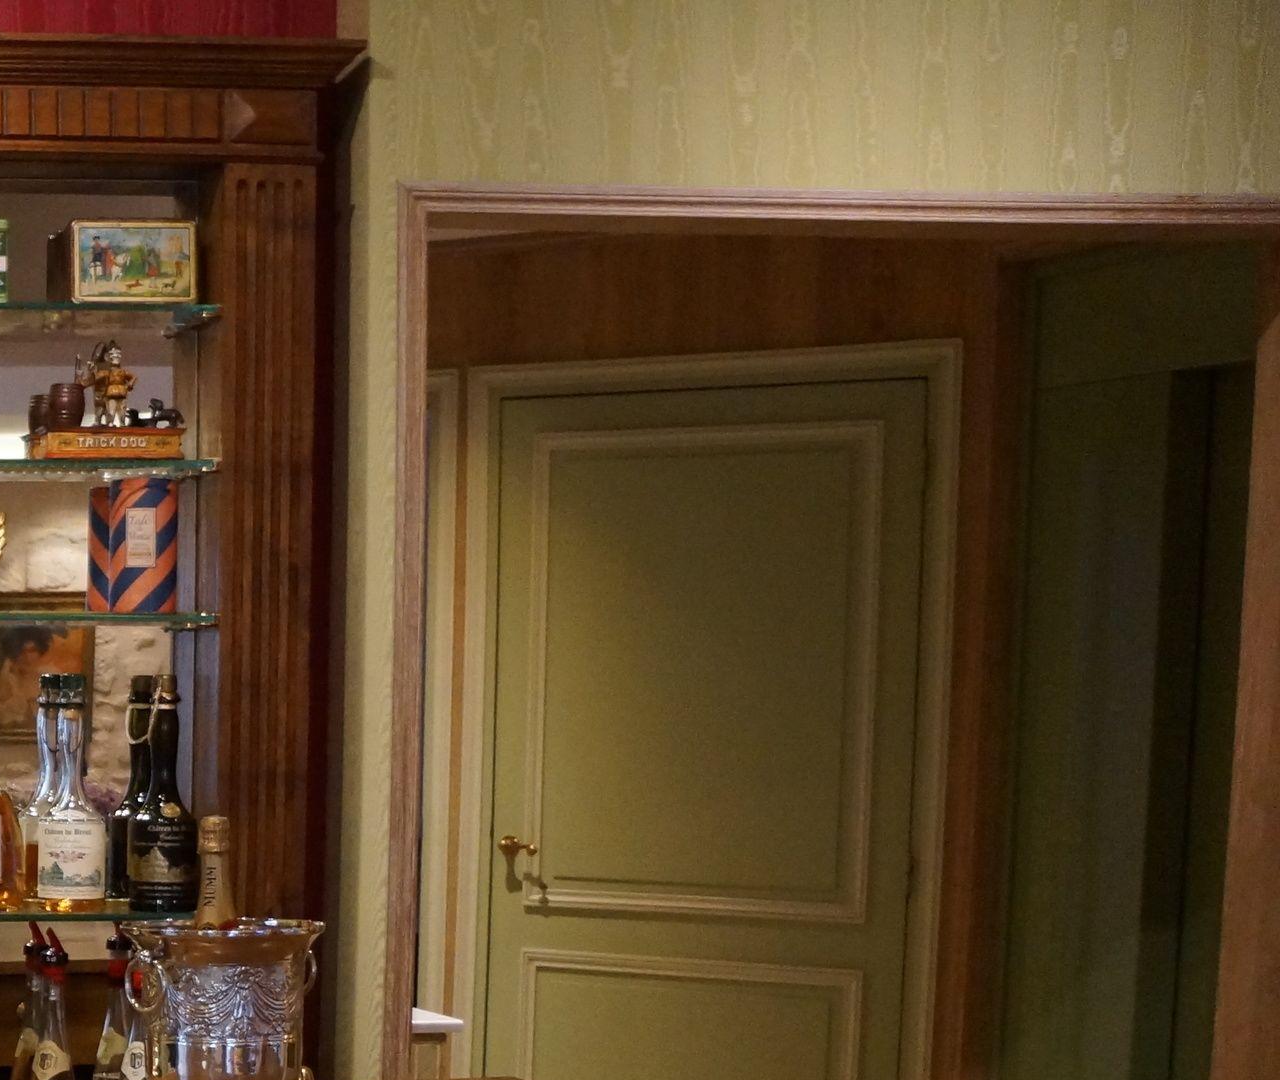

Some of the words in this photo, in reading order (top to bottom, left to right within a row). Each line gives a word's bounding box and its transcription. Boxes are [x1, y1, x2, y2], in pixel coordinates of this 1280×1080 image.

[77, 437, 116, 447] TRICK
[120, 437, 147, 447] DOG
[203, 866, 217, 907] MUMM
